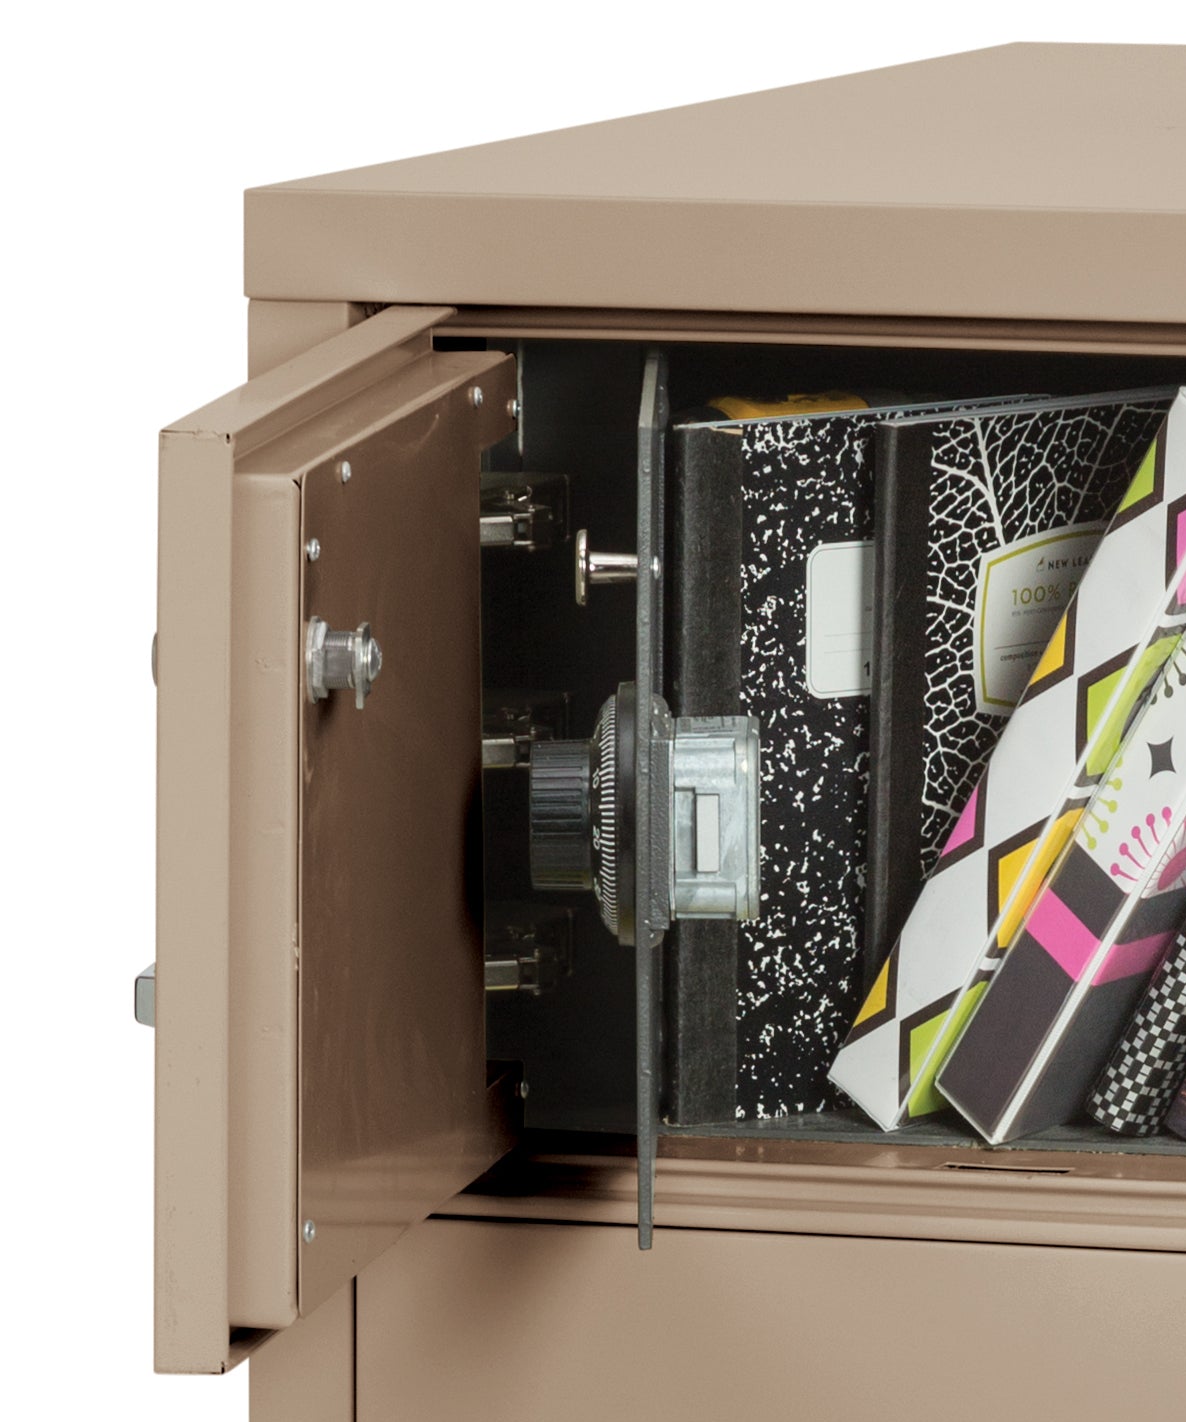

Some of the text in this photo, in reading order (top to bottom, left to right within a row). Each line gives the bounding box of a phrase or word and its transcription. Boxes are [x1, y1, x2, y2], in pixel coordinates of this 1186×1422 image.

[1048, 559, 1068, 570] NEW
[1012, 583, 1060, 605] 100%
[592, 768, 599, 789] 10
[593, 826, 600, 850] 20
